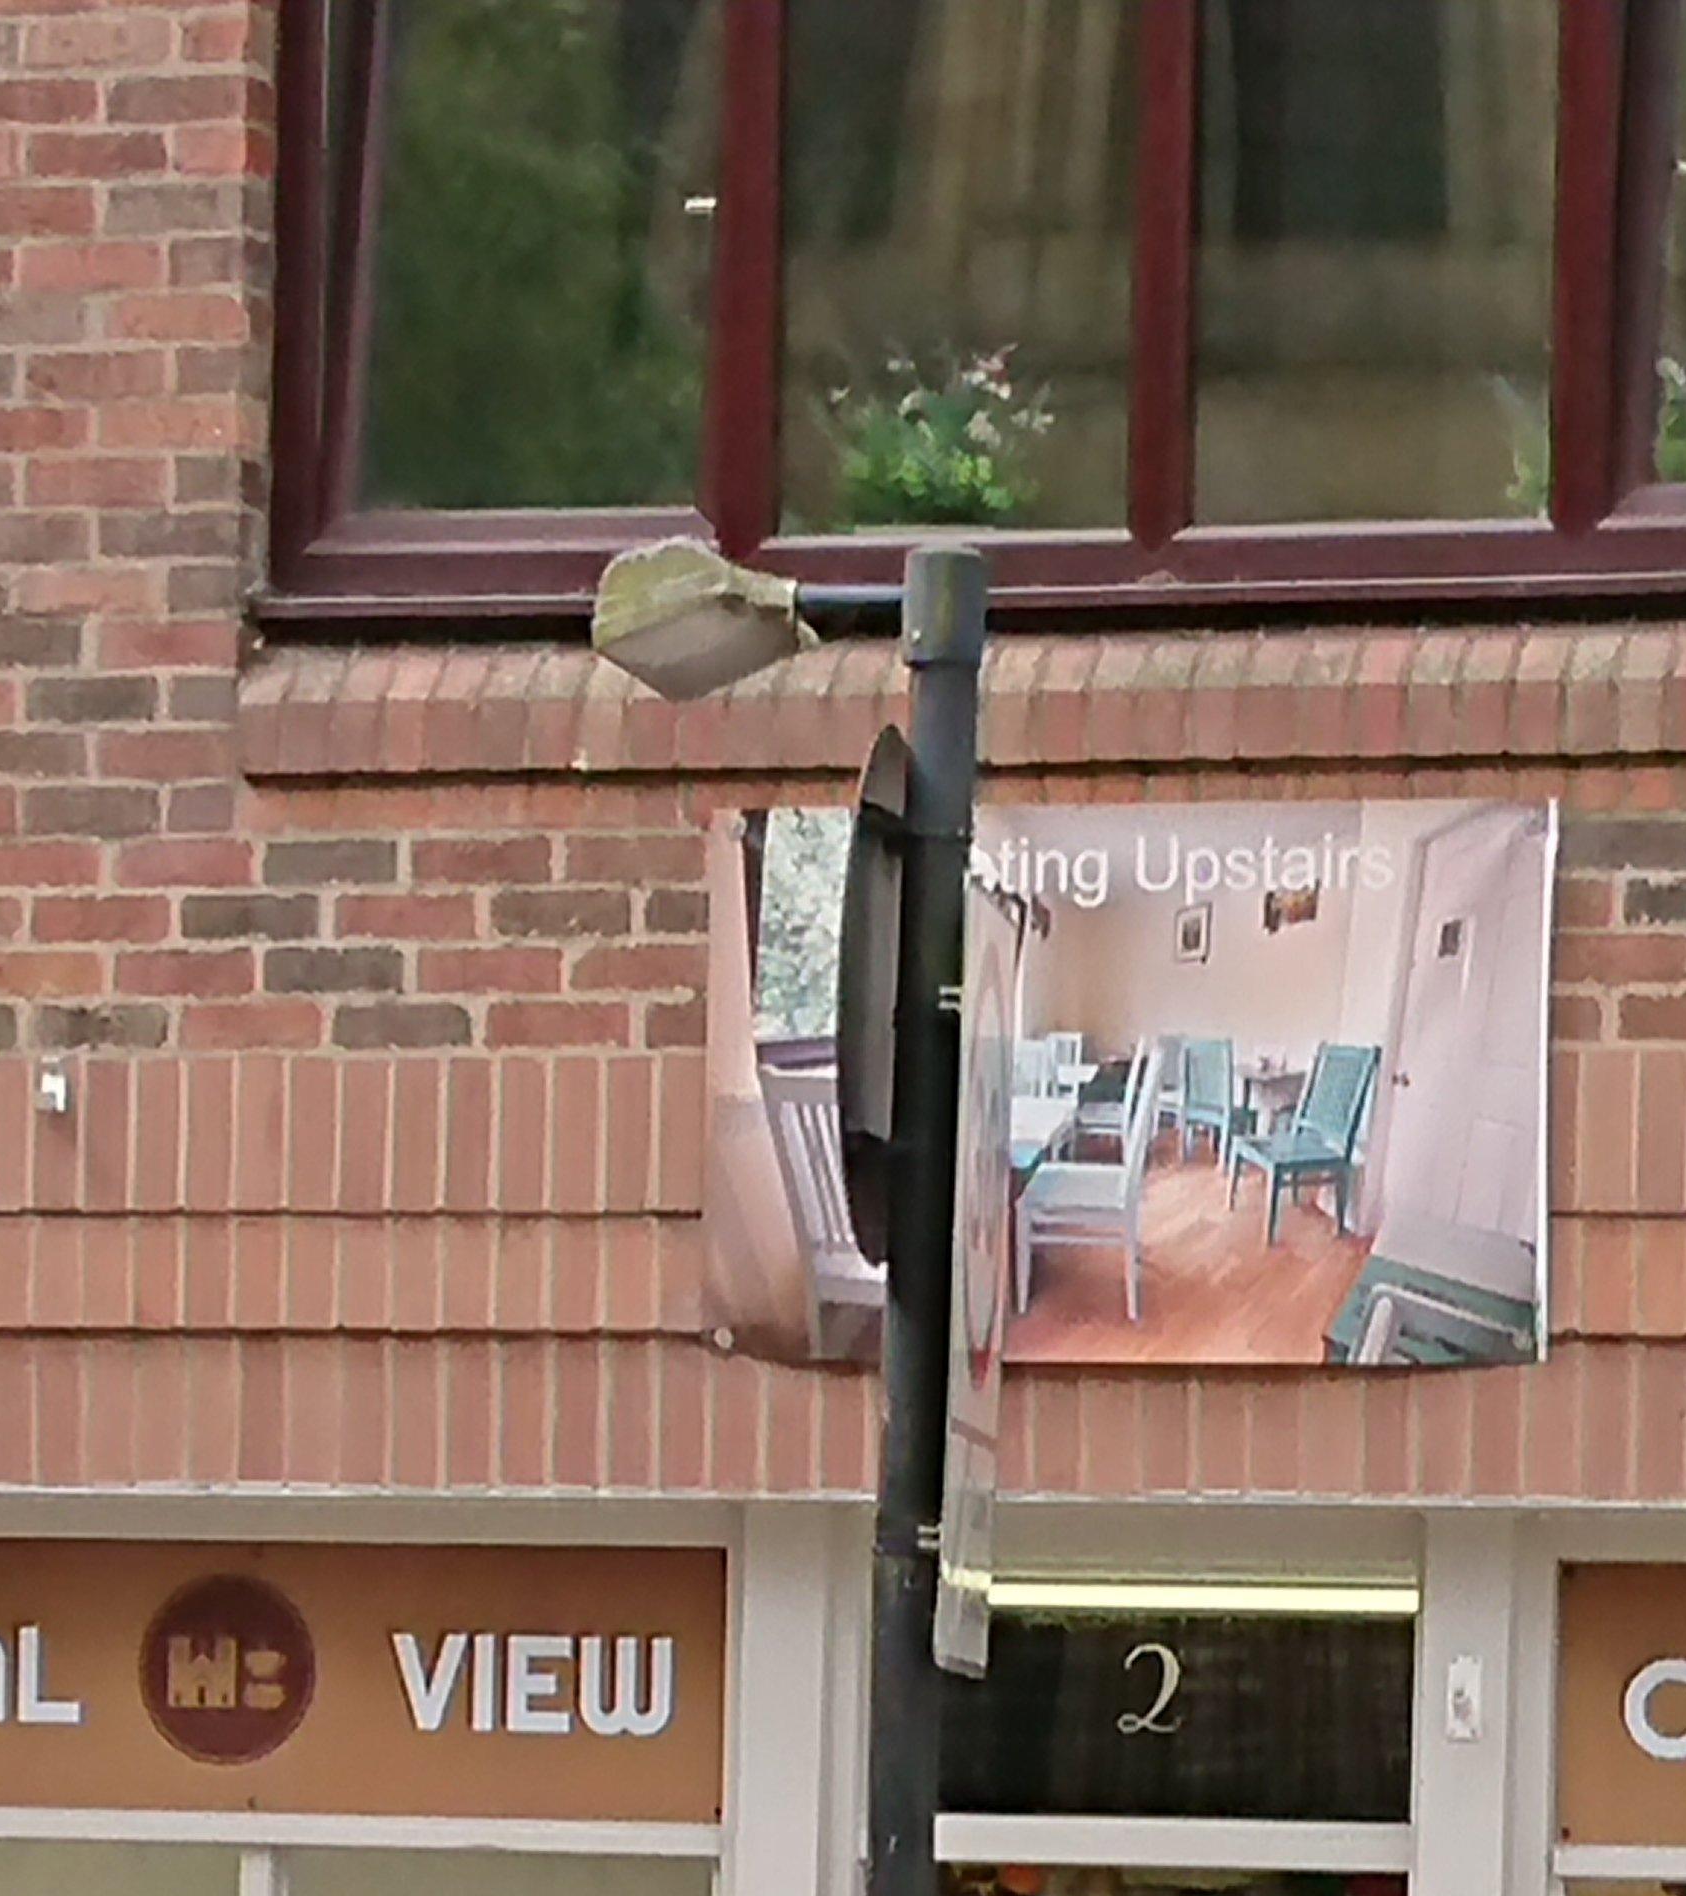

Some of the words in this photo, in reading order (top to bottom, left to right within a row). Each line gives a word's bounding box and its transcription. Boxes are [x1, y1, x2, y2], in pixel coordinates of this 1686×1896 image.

[1134, 831, 1396, 906] Upstairs
[392, 1633, 674, 1738] VIEW
[1117, 1643, 1183, 1735] 2
